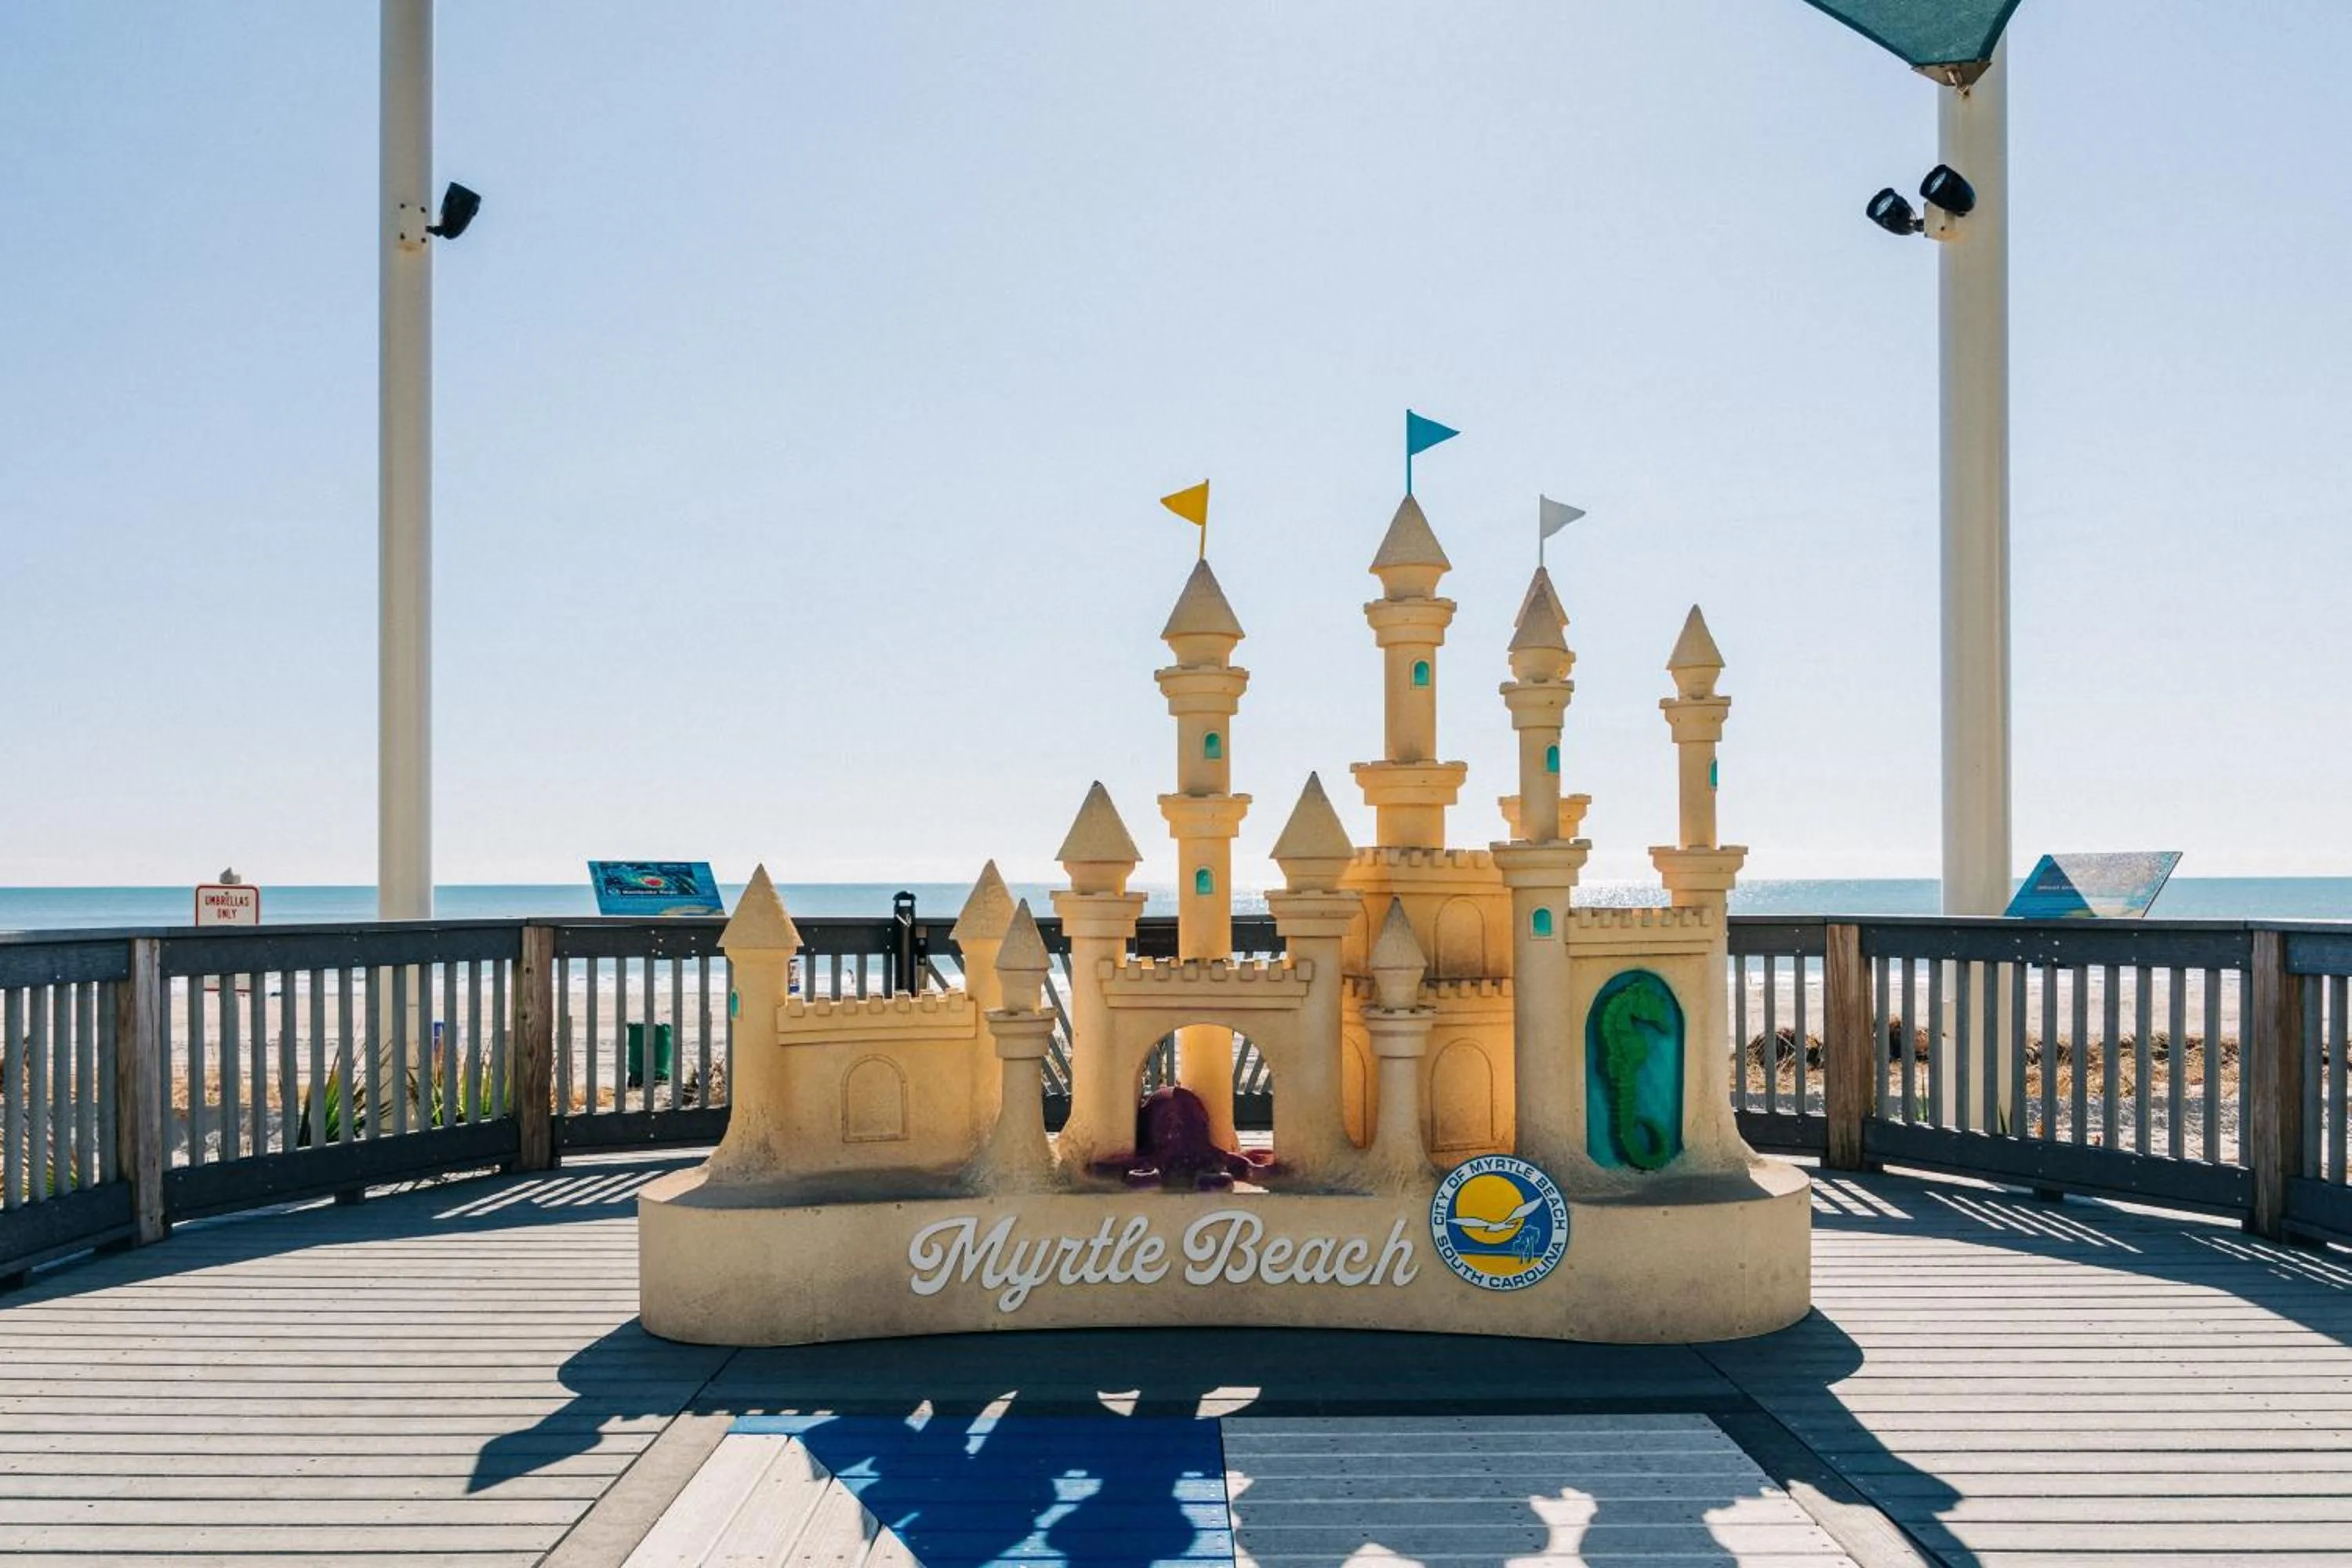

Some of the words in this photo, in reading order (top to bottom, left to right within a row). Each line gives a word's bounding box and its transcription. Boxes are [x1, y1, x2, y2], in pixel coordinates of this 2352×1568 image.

[205, 895, 249, 907] UMBRELLAS
[216, 908, 238, 919] ONLY
[1434, 1191, 1450, 1225] CITY
[1446, 1170, 1467, 1189] OF
[1468, 1158, 1535, 1178] MYRTLE
[1535, 1176, 1566, 1230] BEACH
[909, 1214, 1171, 1312] Myrtle
[1182, 1209, 1419, 1287] Beach
[1436, 1235, 1484, 1285] SOUTH
[1489, 1241, 1564, 1288] CAROLINA
